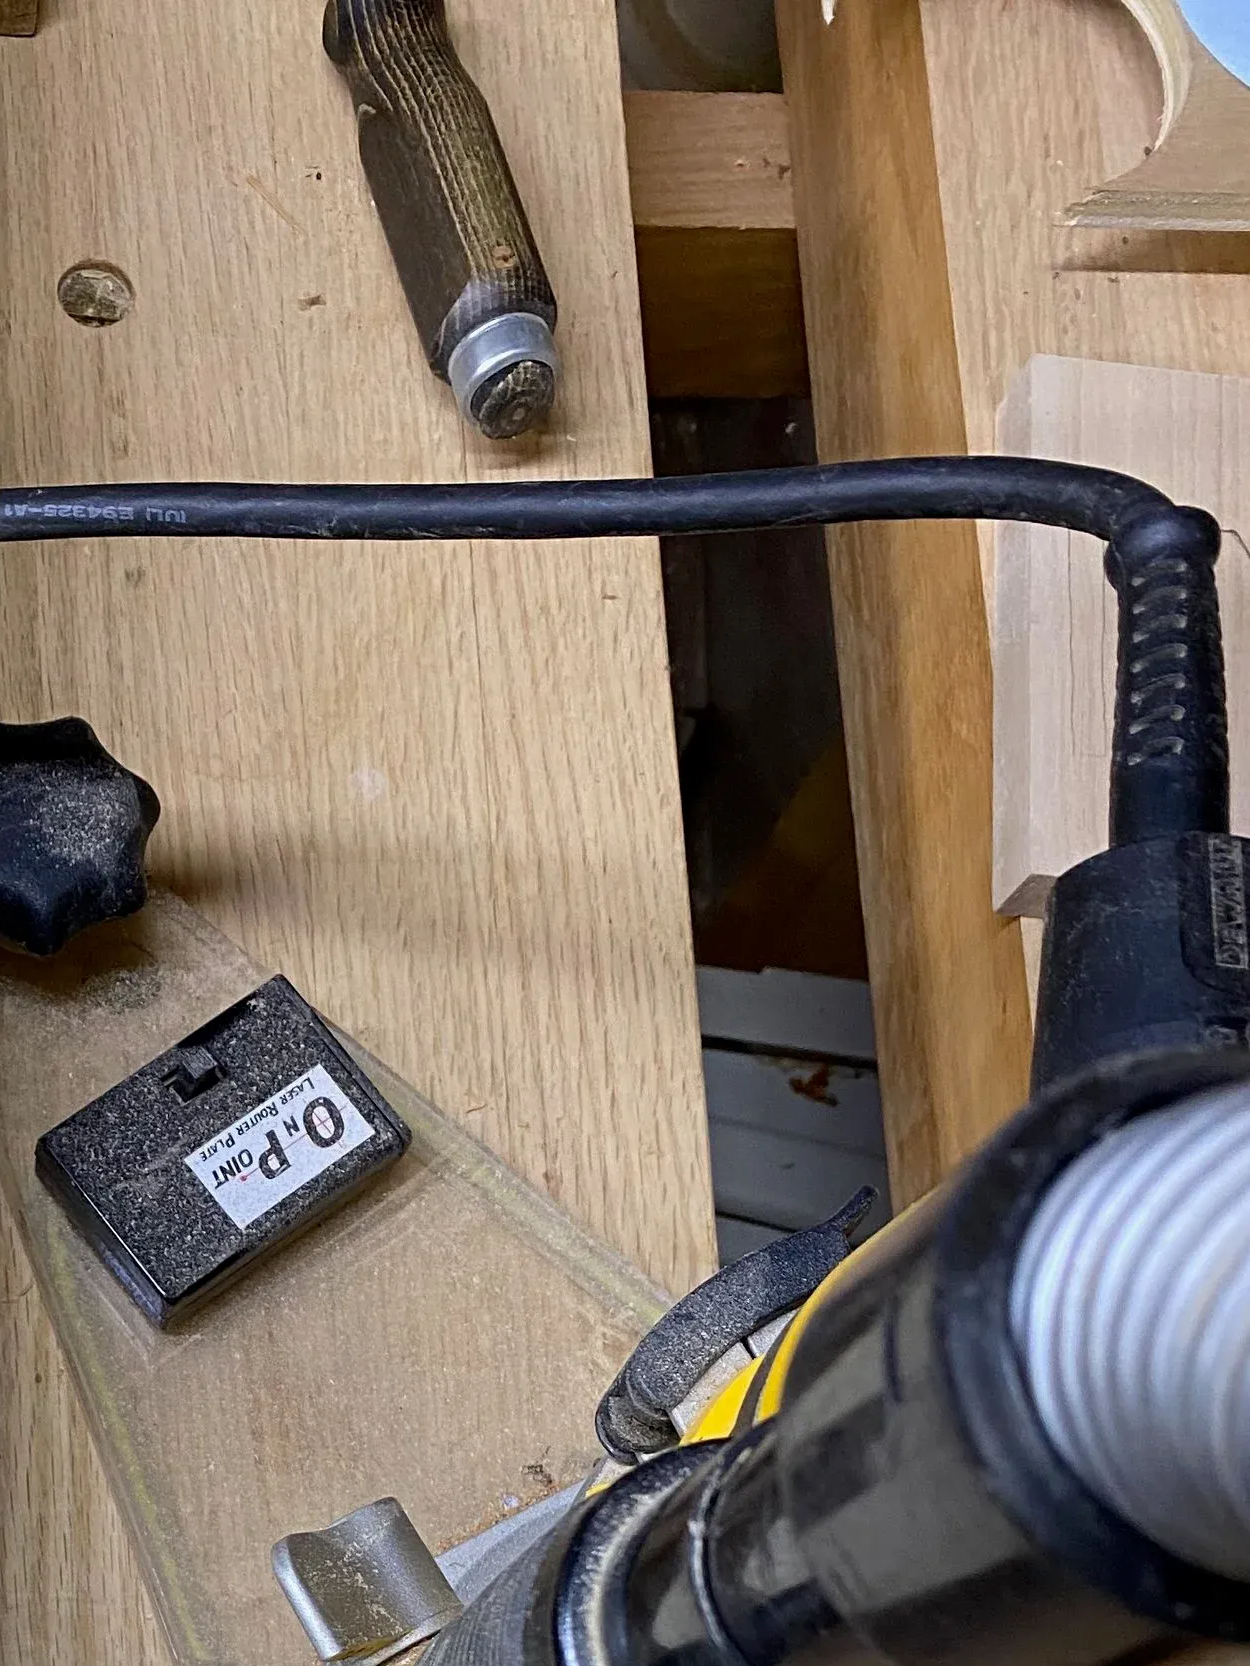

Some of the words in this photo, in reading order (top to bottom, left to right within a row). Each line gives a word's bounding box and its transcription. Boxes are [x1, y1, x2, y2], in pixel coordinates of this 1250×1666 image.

[1211, 838, 1247, 964] DEWALT
[279, 1077, 315, 1105] LASER
[236, 1104, 279, 1136] ROUTER
[199, 1139, 236, 1162] PLATE
